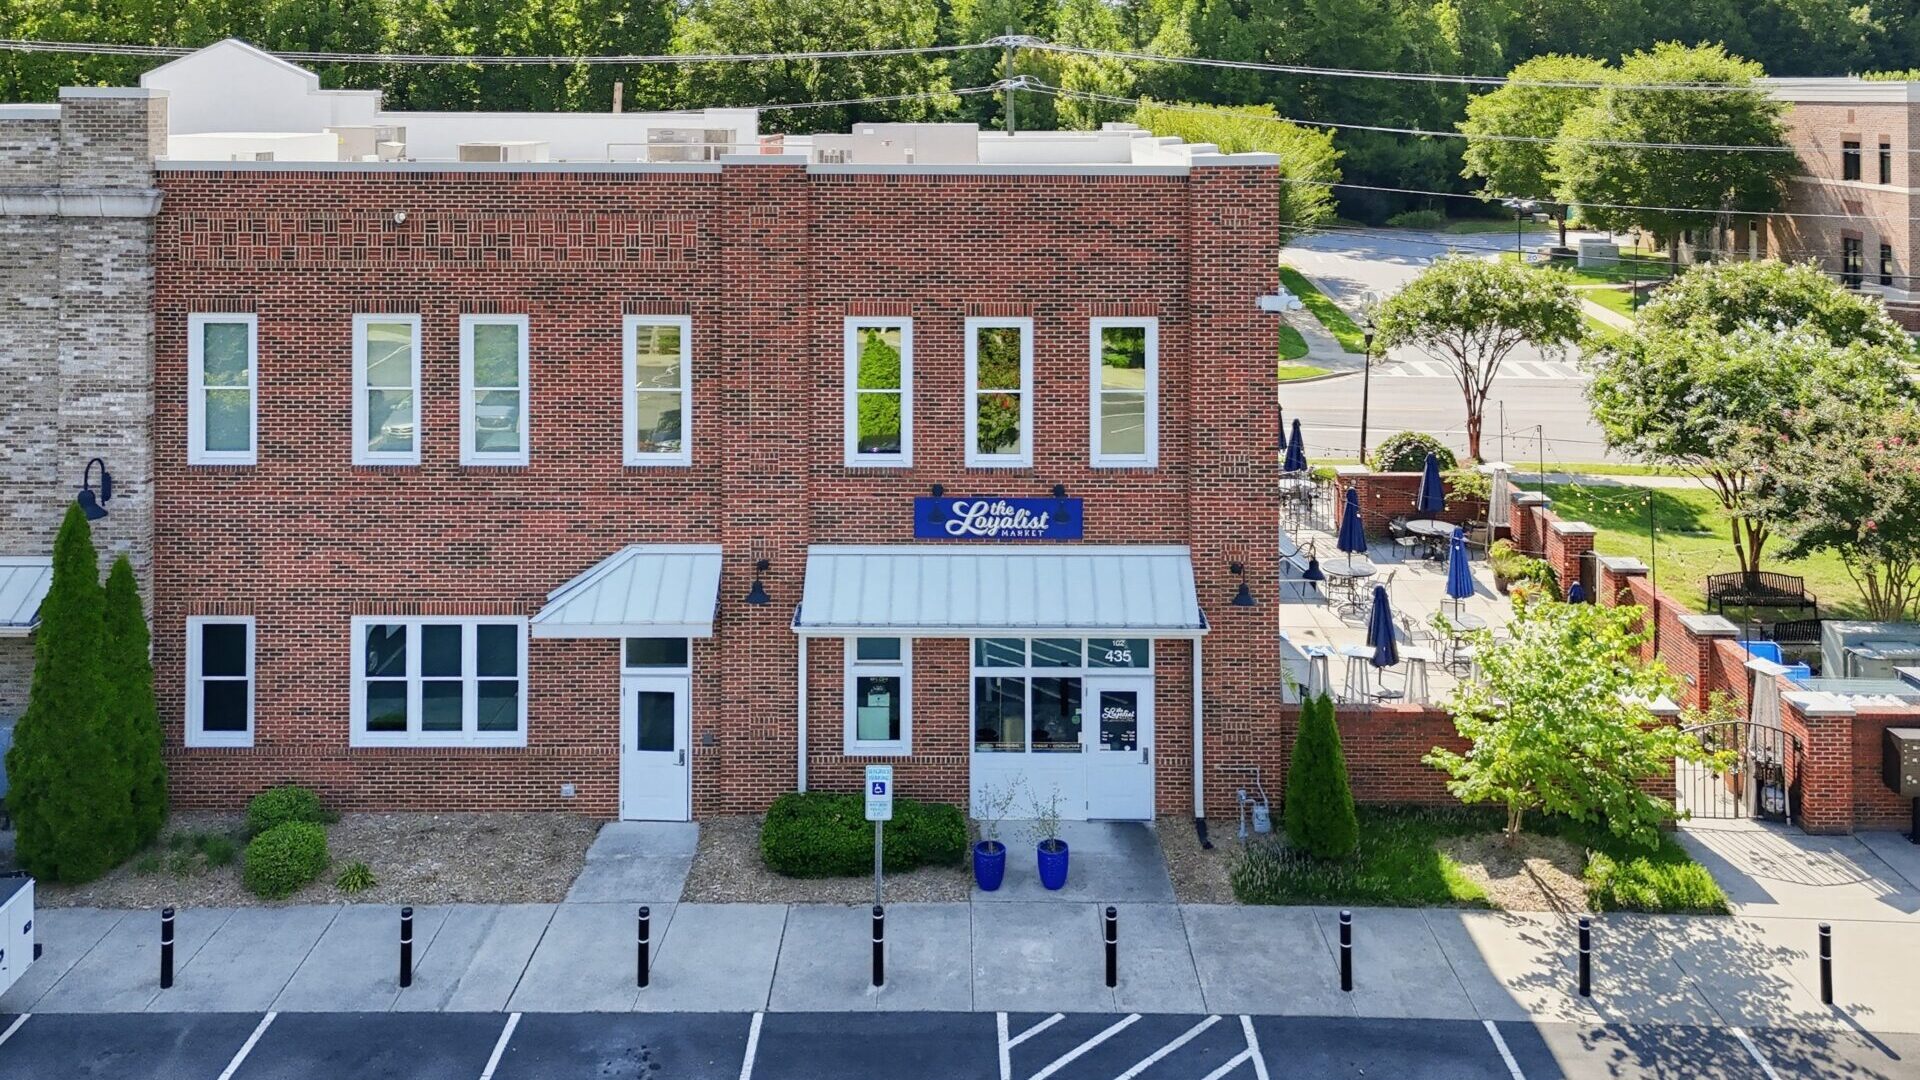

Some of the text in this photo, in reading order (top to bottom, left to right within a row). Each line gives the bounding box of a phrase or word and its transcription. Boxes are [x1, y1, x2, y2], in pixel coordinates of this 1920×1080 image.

[990, 500, 1015, 516] the
[945, 500, 1050, 536] Loyalist
[1001, 529, 1045, 537] MARKET
[1112, 639, 1125, 647] 102
[1104, 649, 1132, 662] 435
